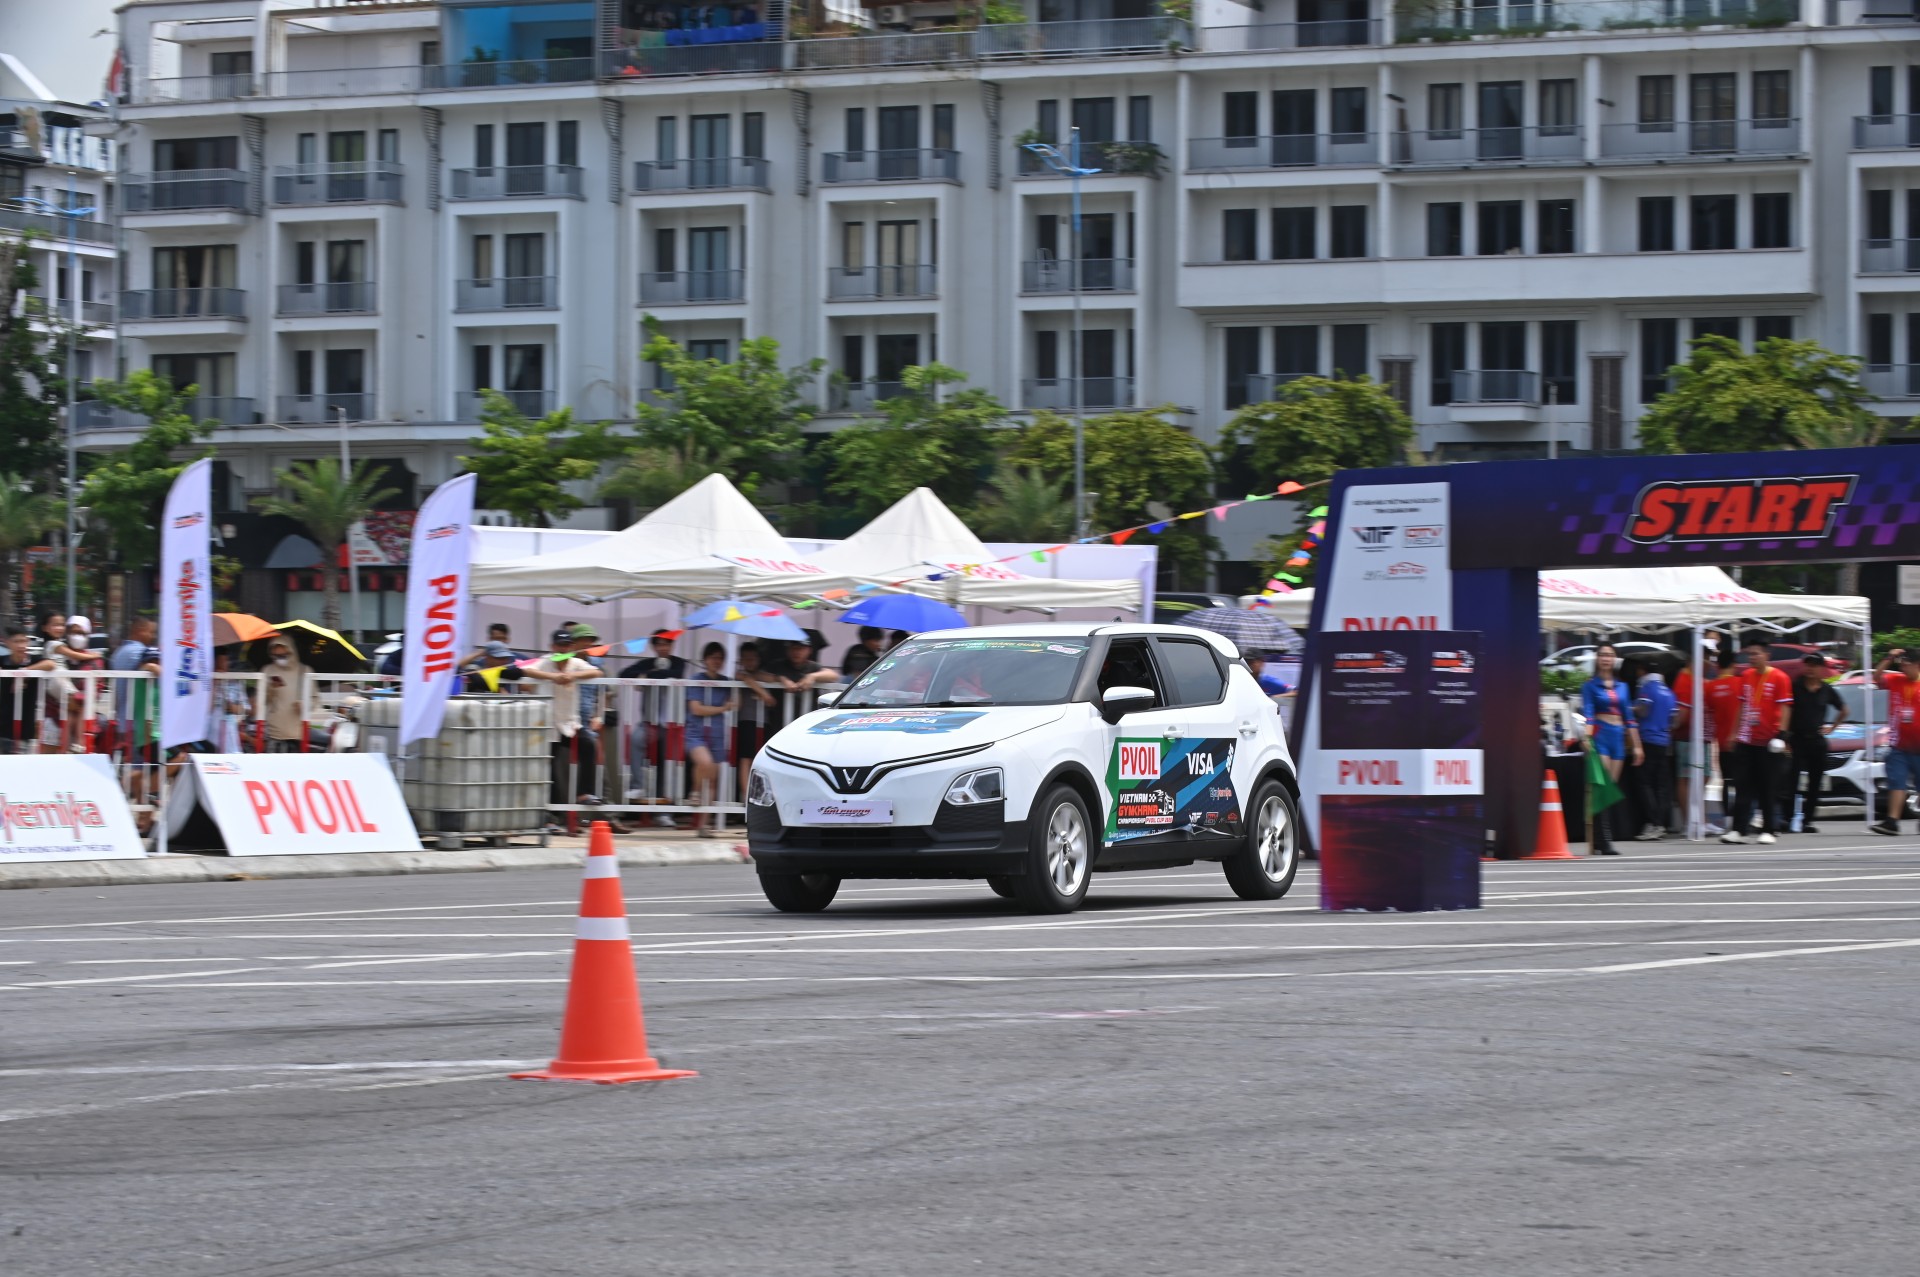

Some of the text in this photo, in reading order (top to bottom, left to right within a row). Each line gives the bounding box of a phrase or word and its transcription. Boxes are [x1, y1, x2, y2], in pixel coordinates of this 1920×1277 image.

[1632, 482, 1848, 537] START
[422, 574, 459, 682] PVOIL
[1121, 746, 1158, 776] PVOIL
[1185, 752, 1214, 775] VISA
[1338, 759, 1403, 786] PVOIL
[242, 779, 380, 835] PVOIL
[1118, 804, 1159, 817] GYMKHANA
[1119, 793, 1149, 804] VIETNAM
